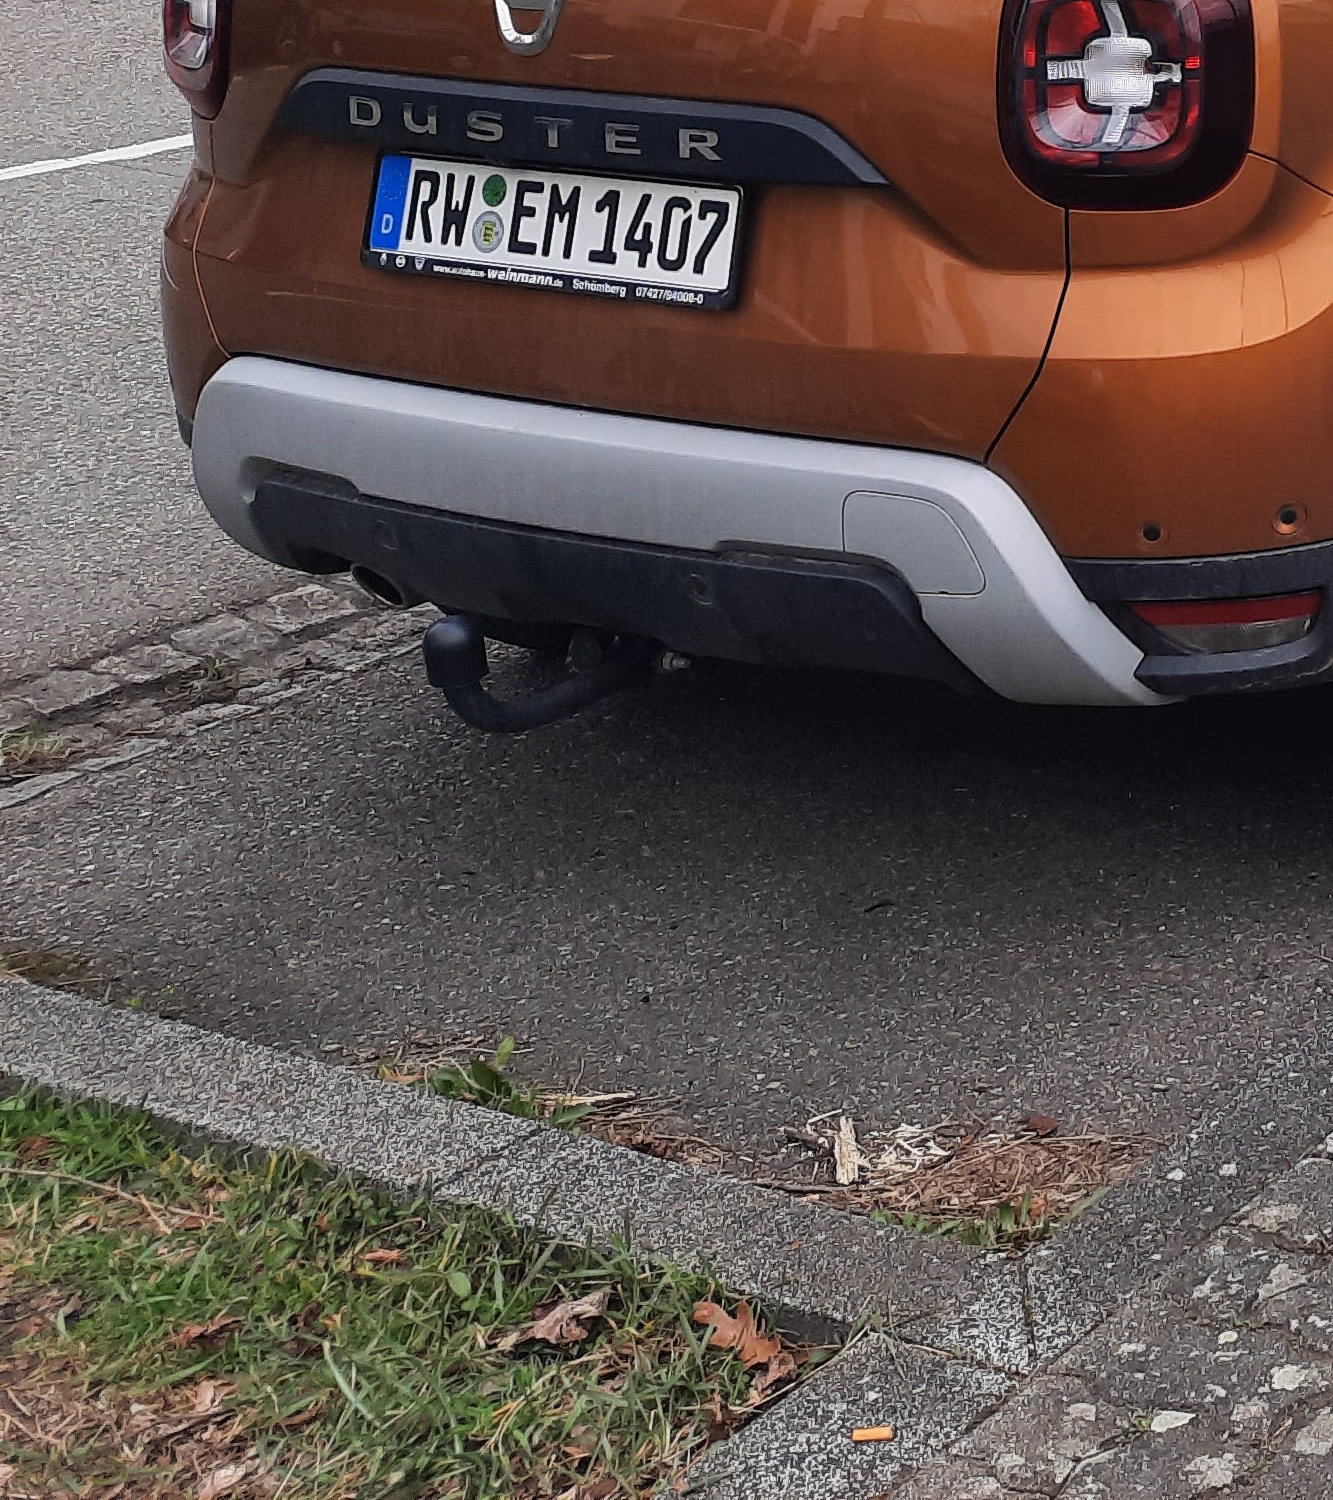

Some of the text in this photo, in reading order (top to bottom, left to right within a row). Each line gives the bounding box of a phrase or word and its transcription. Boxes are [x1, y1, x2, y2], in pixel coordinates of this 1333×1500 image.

[348, 95, 722, 161] DUSTER
[381, 213, 394, 234] D
[405, 169, 730, 275] RW EM 1407
